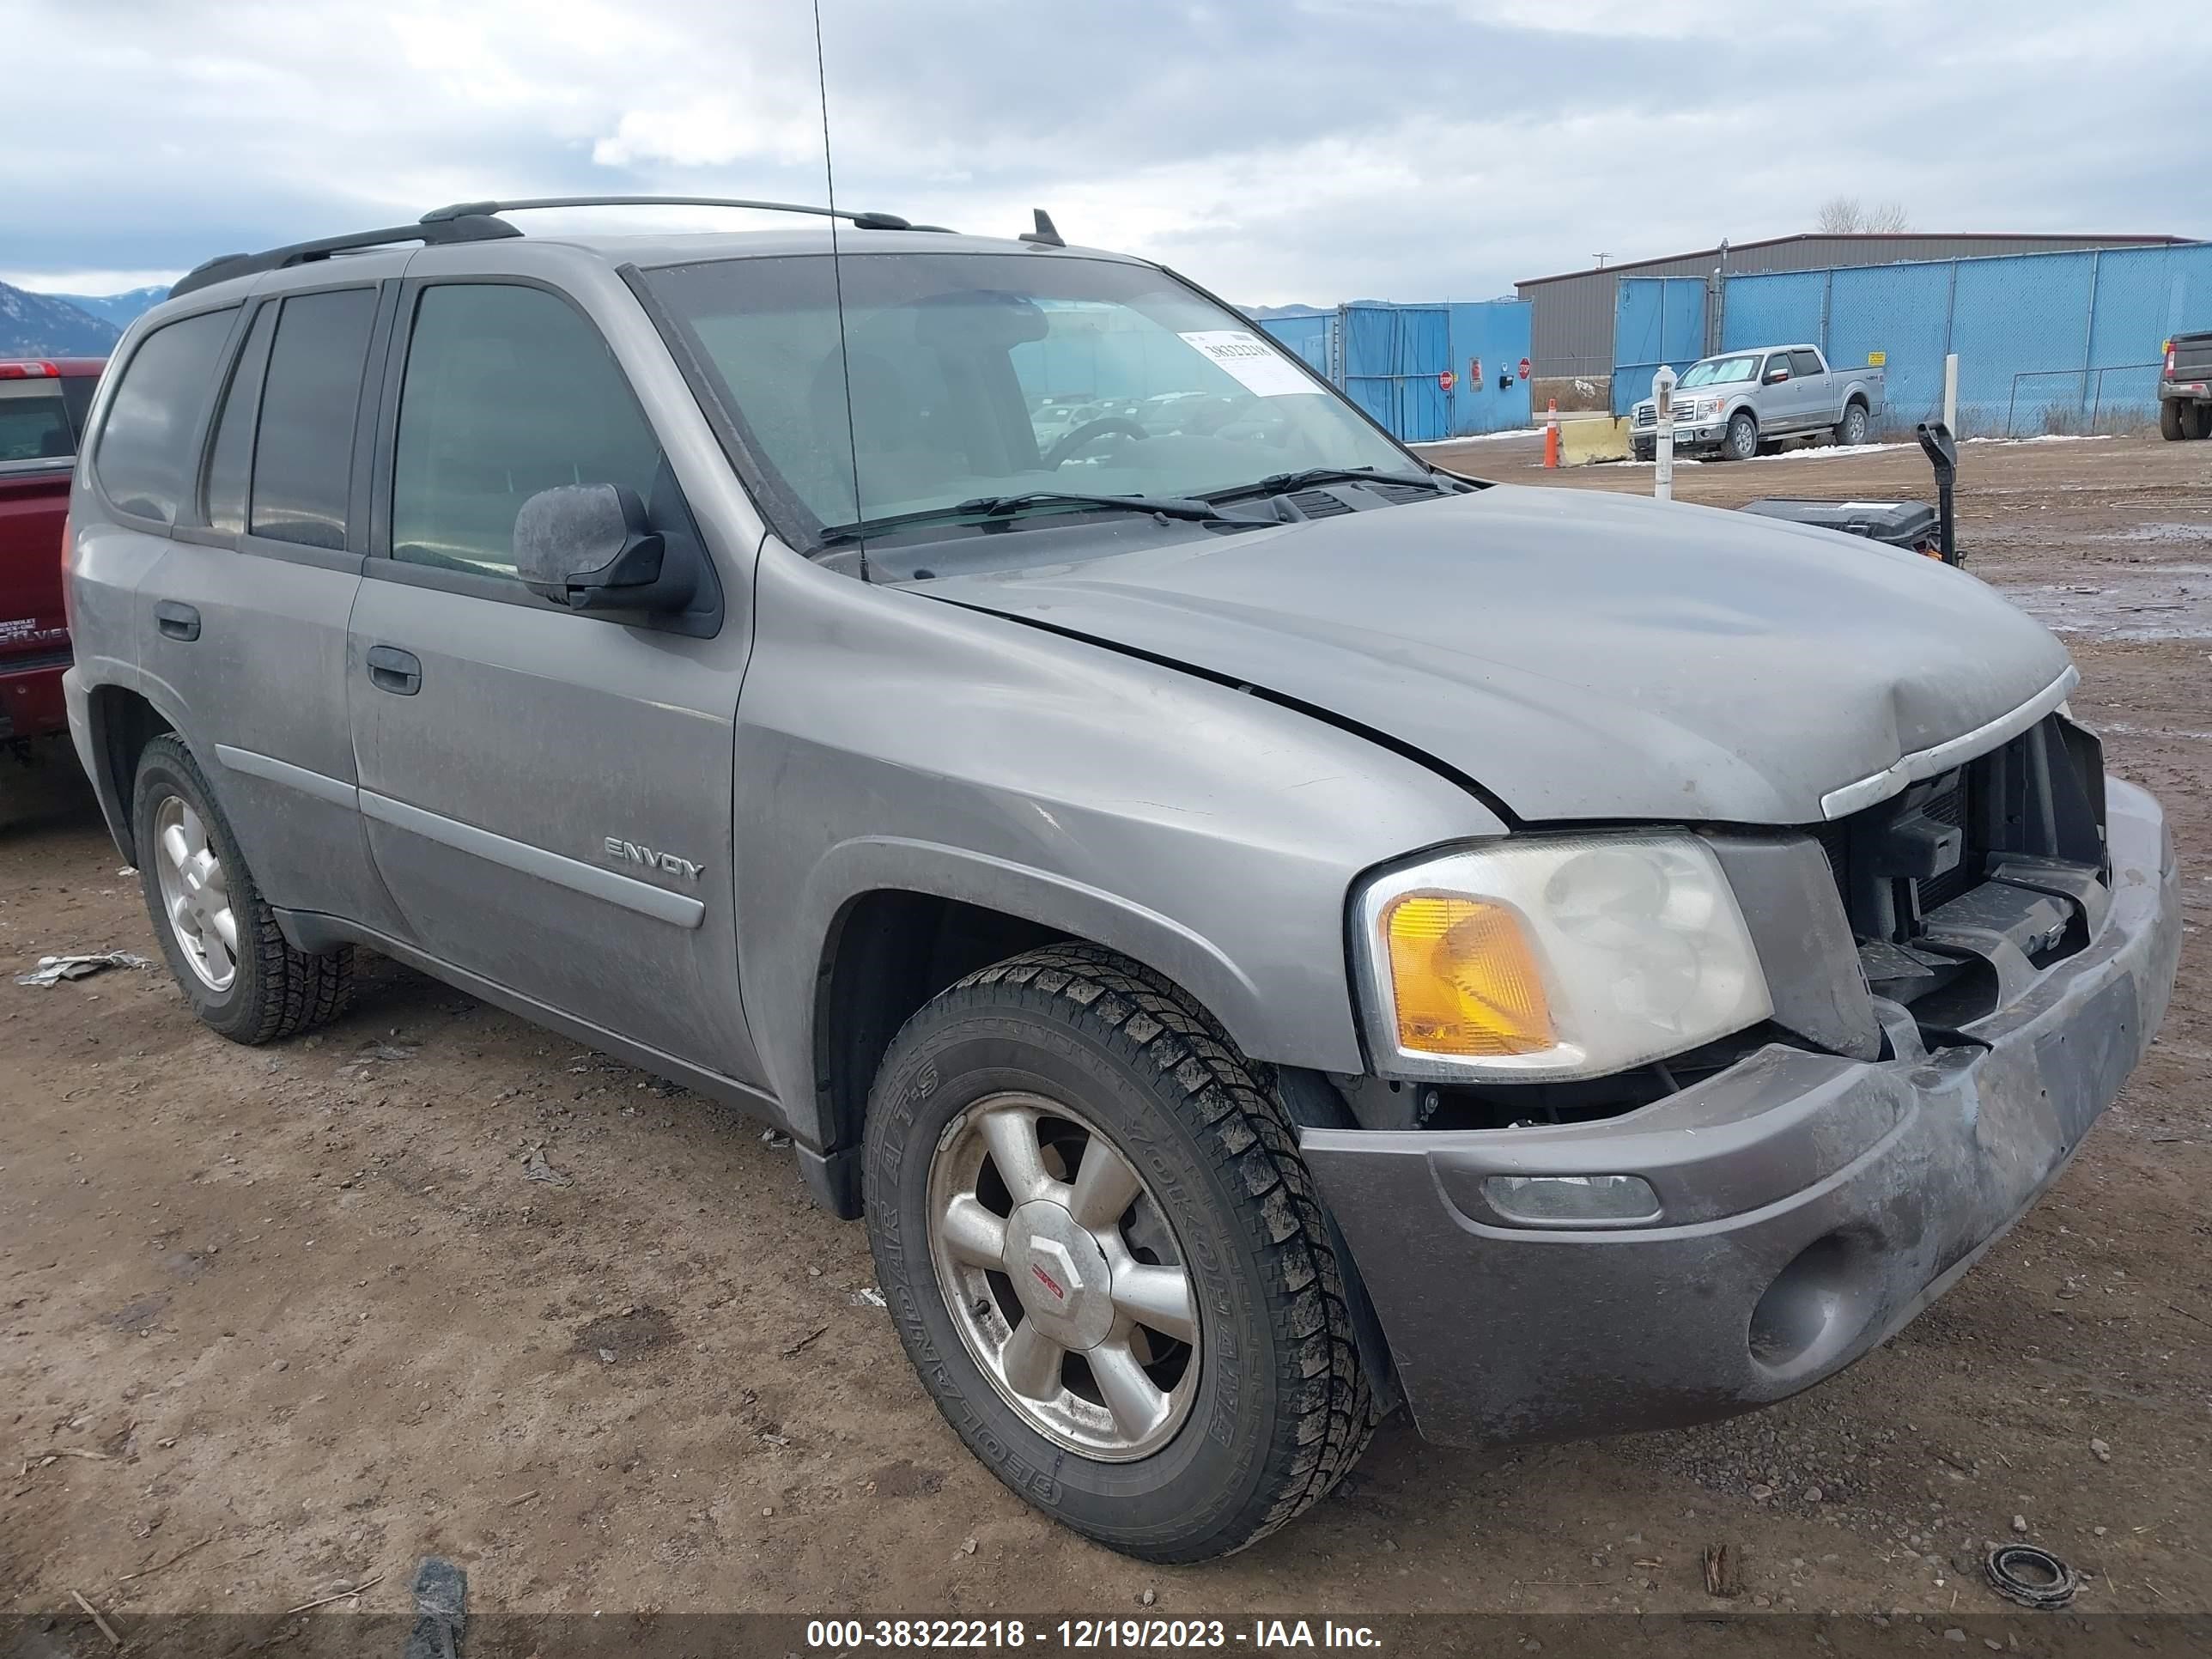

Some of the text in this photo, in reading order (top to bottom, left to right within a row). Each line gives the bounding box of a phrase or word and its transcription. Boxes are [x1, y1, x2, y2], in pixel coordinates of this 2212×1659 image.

[1205, 344, 1272, 357] 38322218
[604, 836, 706, 880] ENVOY
[1031, 1262, 1064, 1299] GMC
[1121, 1114, 1241, 1449] YOKOHAMA
[880, 1200, 1062, 1507] GEOLANDAR
